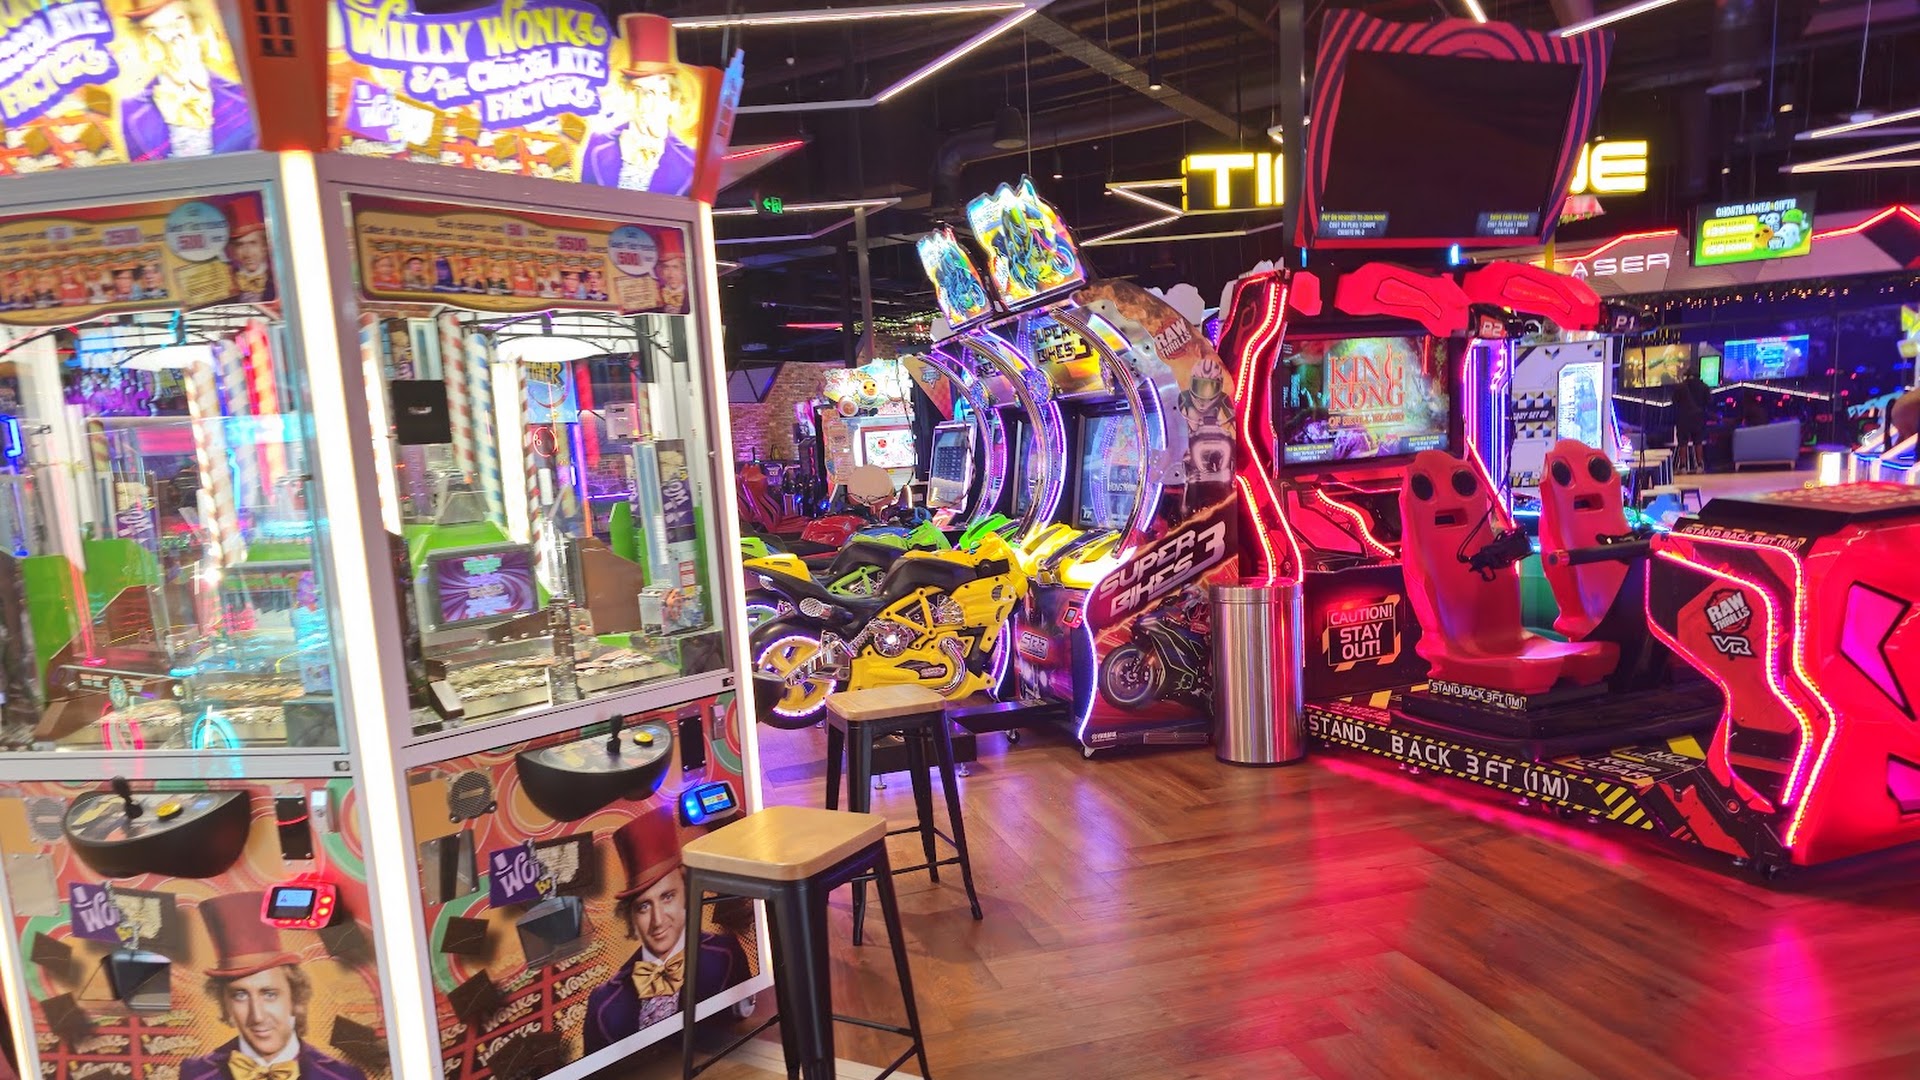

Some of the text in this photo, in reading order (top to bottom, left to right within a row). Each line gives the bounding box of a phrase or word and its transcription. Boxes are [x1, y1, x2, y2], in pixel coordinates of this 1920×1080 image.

[347, 2, 609, 63] WILLY WONKA
[466, 46, 605, 92] CHOCOLATE
[486, 76, 598, 122] FACTORY
[1571, 253, 1670, 277] ASER
[1154, 318, 1189, 349] RAW
[1482, 320, 1503, 335] P2
[1616, 315, 1635, 330] P1
[1160, 332, 1192, 358] THRILLS
[1329, 346, 1404, 386] KING
[1329, 382, 1405, 411] KONG
[1684, 527, 1721, 538] STAND
[1722, 532, 1752, 542] BACK
[1099, 530, 1196, 600] SUPER
[1110, 552, 1194, 618] BIKES
[1330, 604, 1393, 626] CAUTION!
[1706, 591, 1746, 624] RAW
[1713, 606, 1751, 632] THRILLS
[1340, 622, 1383, 644] STAY
[1711, 634, 1752, 656] VR
[1342, 639, 1381, 660] OUT!
[1432, 682, 1523, 708] STAND BACK 3FT (1M)
[1308, 715, 1367, 744] STAND
[1391, 735, 1452, 768] BACK
[1523, 768, 1570, 801] (1M)
[1598, 757, 1662, 773] KEEP
[483, 992, 542, 1033] WONKA
